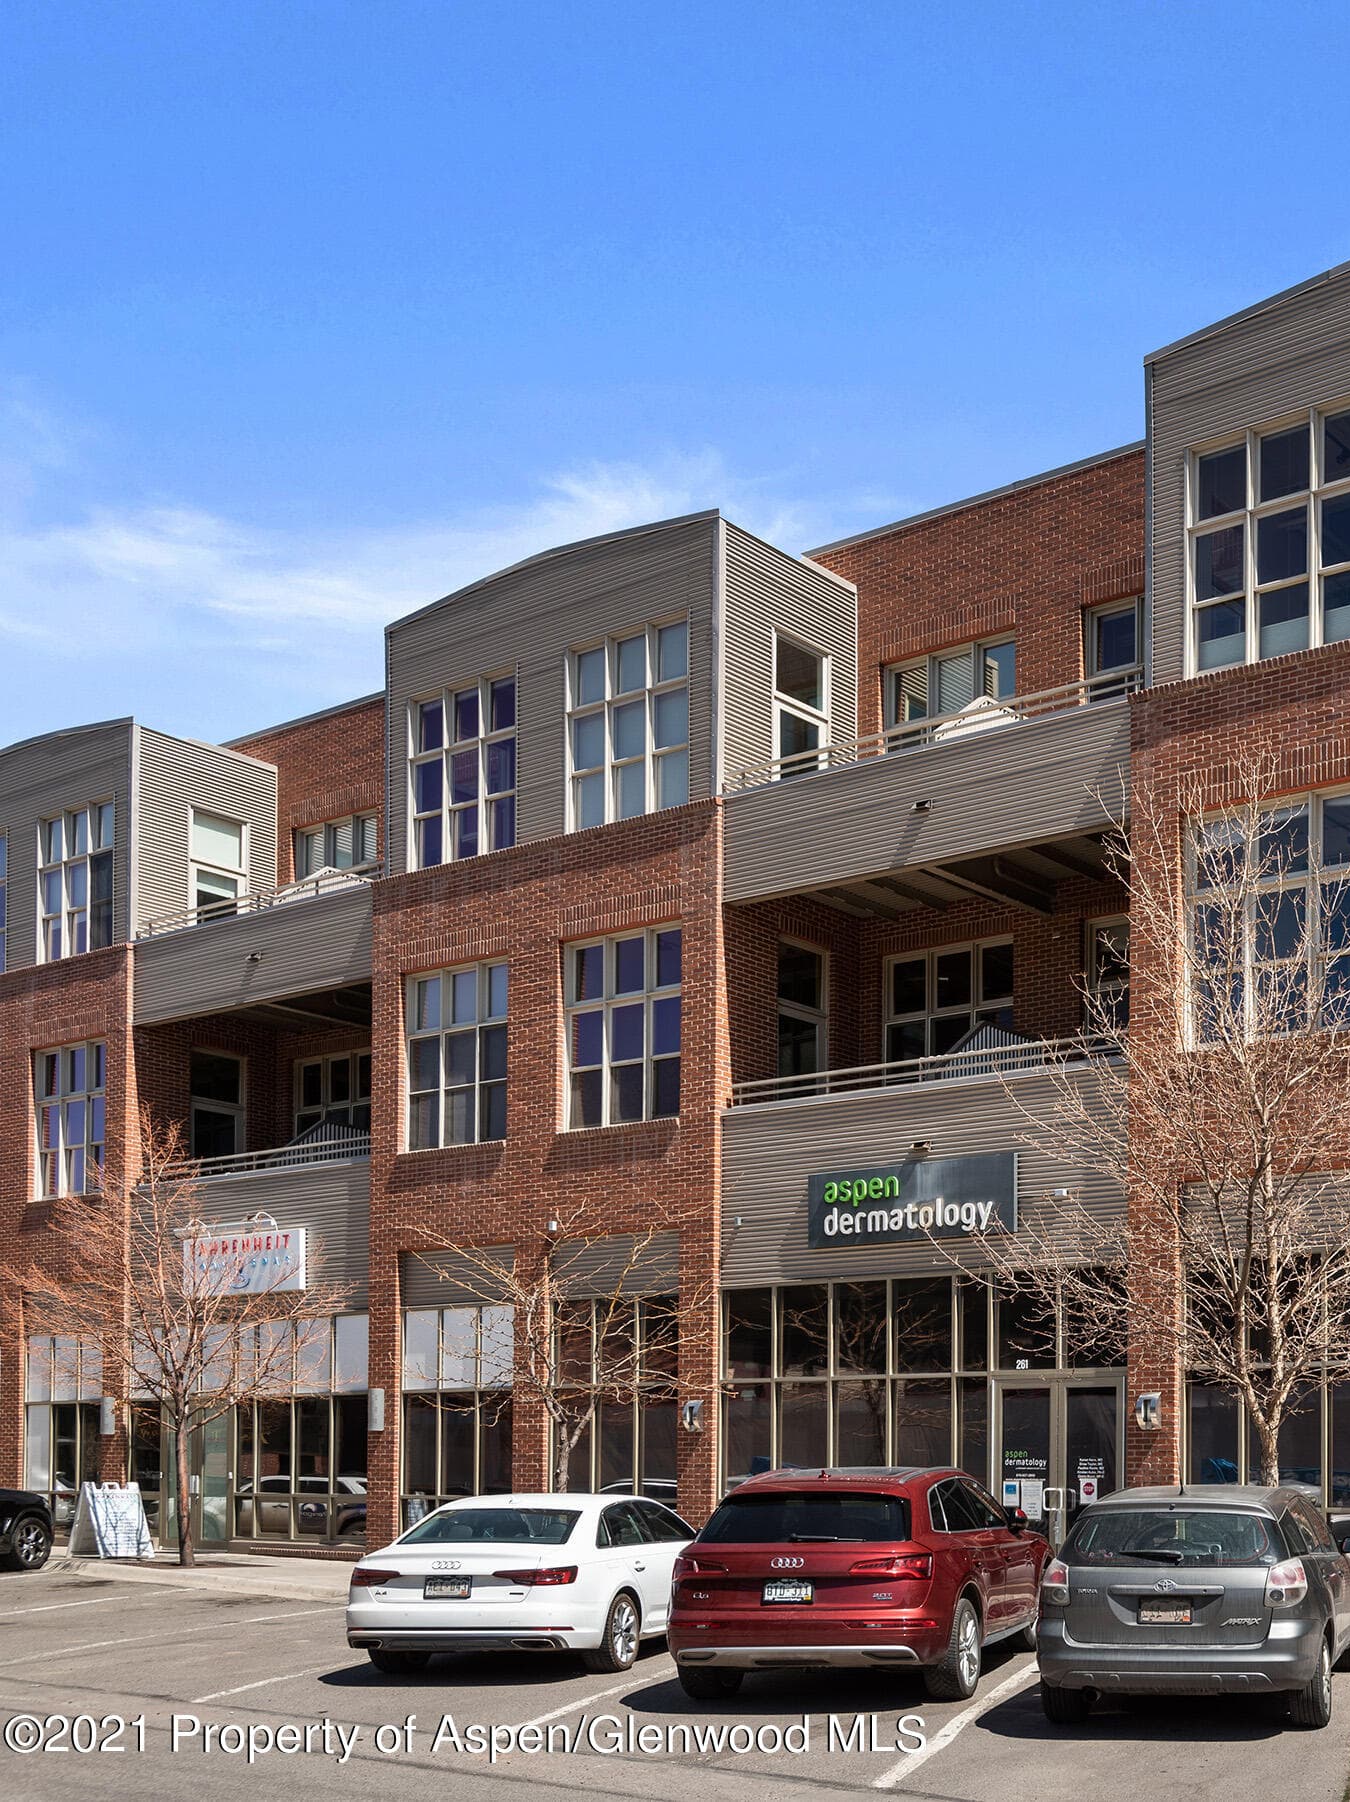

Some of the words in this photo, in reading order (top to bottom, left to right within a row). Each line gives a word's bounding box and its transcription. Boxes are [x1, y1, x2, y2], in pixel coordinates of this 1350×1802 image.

[823, 1175, 899, 1207] aspen
[823, 1197, 994, 1237] dermatology
[1015, 1359, 1029, 1370] 261
[1004, 1450, 1029, 1458] aspen
[1004, 1458, 1047, 1467] dermatology
